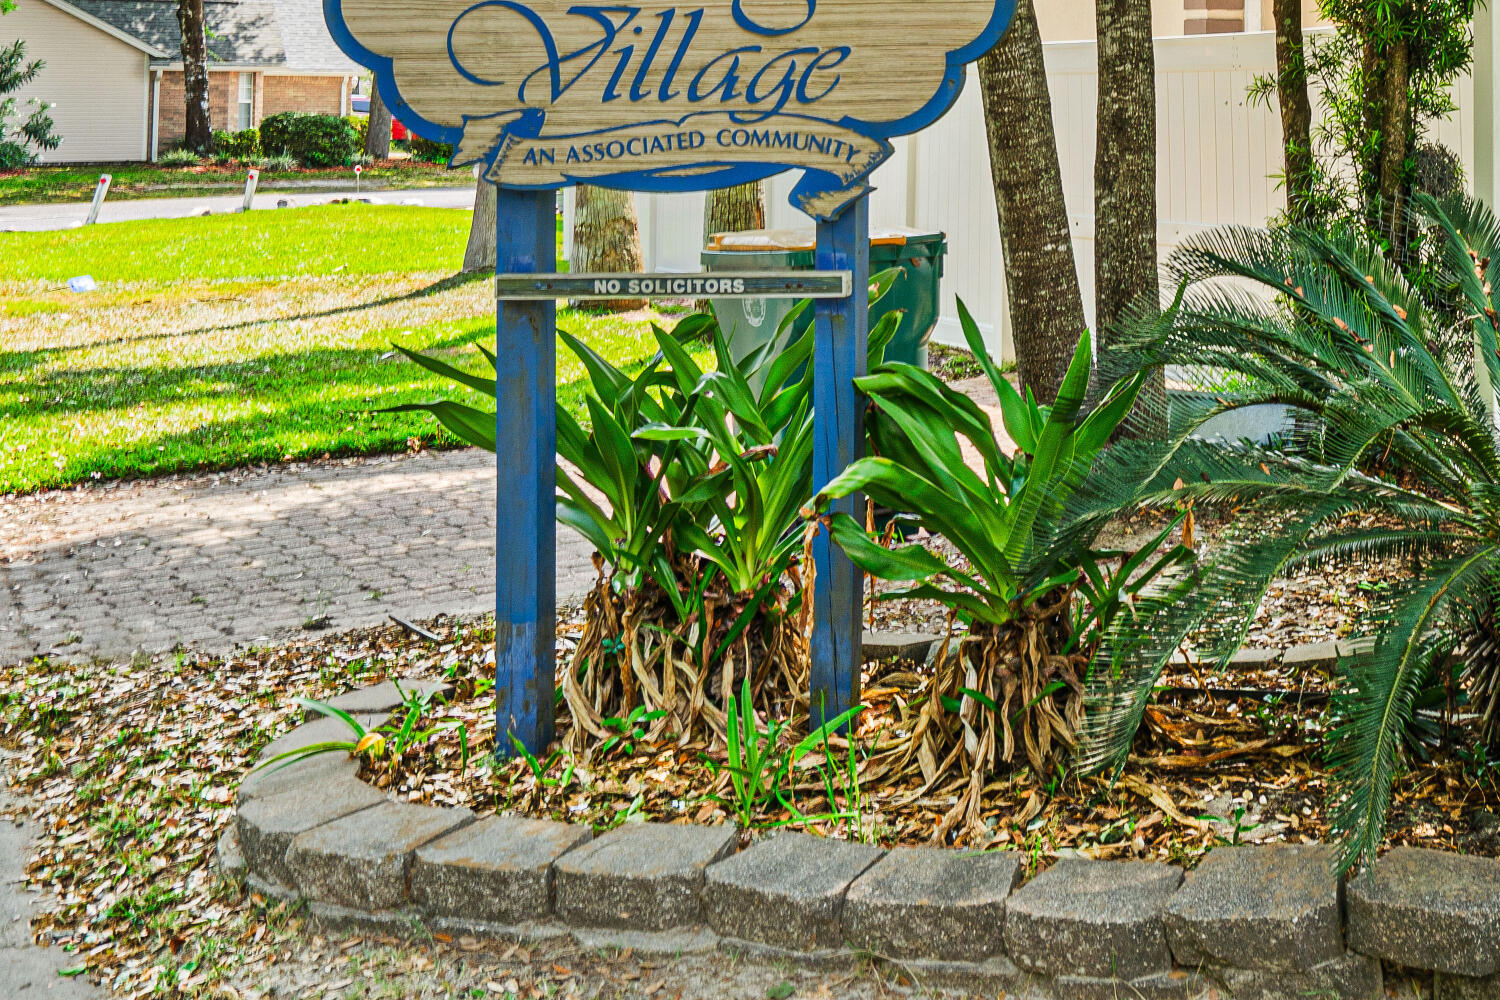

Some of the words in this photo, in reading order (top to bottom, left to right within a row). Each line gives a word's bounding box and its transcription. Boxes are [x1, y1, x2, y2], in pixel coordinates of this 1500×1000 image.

[446, 0, 852, 124] Village
[522, 147, 556, 166] AN
[565, 131, 705, 164] ASSOCIATED
[716, 128, 861, 164] COMMUNITY
[594, 279, 620, 294] NO
[628, 278, 745, 294] SOLICITORS
